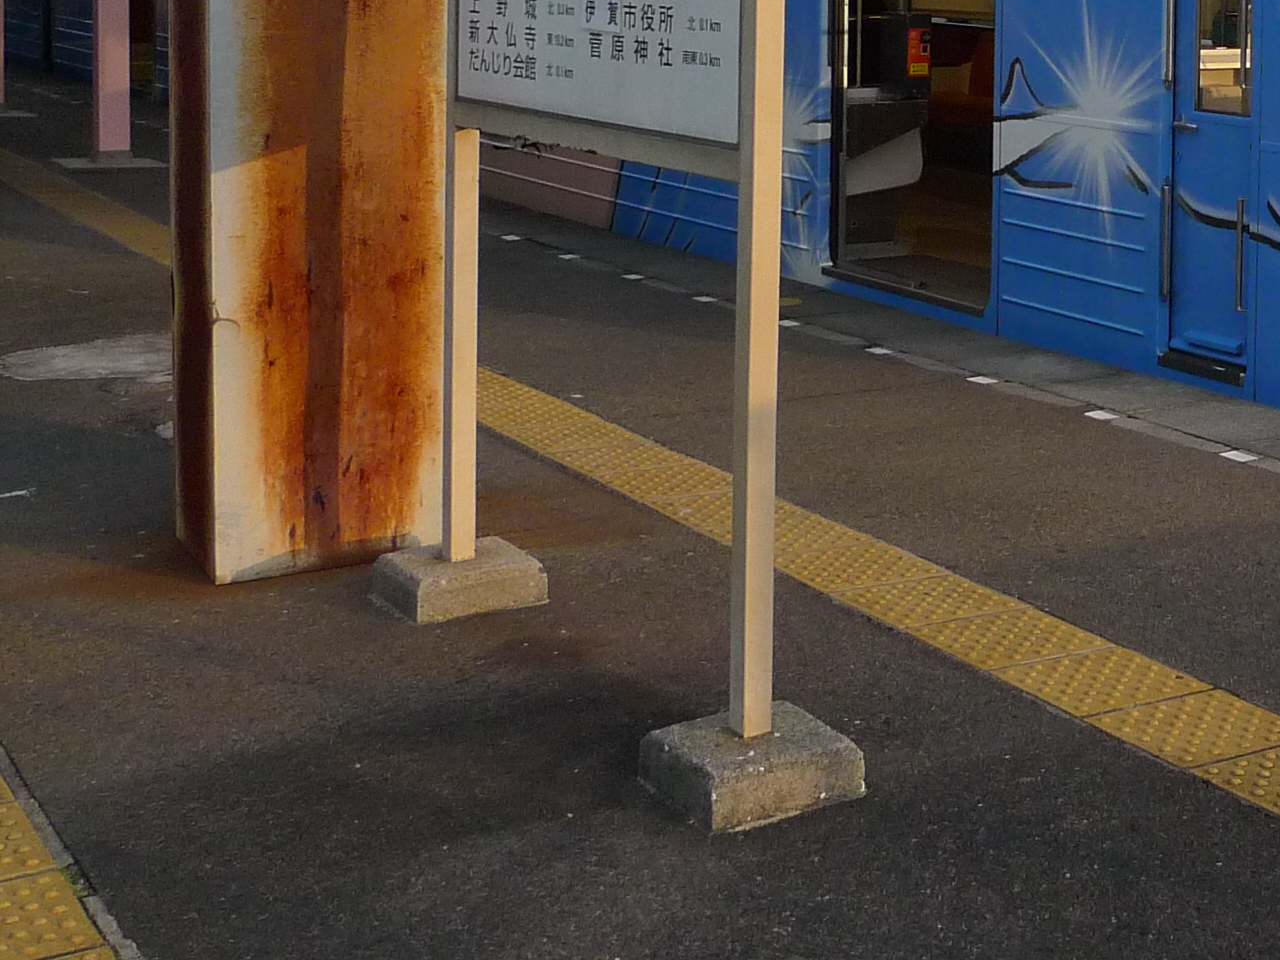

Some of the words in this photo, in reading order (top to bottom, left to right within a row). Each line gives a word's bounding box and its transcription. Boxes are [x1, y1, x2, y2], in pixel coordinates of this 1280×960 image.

[585, 0, 674, 34] 伊賀市役所
[469, 20, 537, 50] 新大仏寺
[589, 32, 673, 67] 菅原神社
[469, 48, 537, 80] だんじり会館
